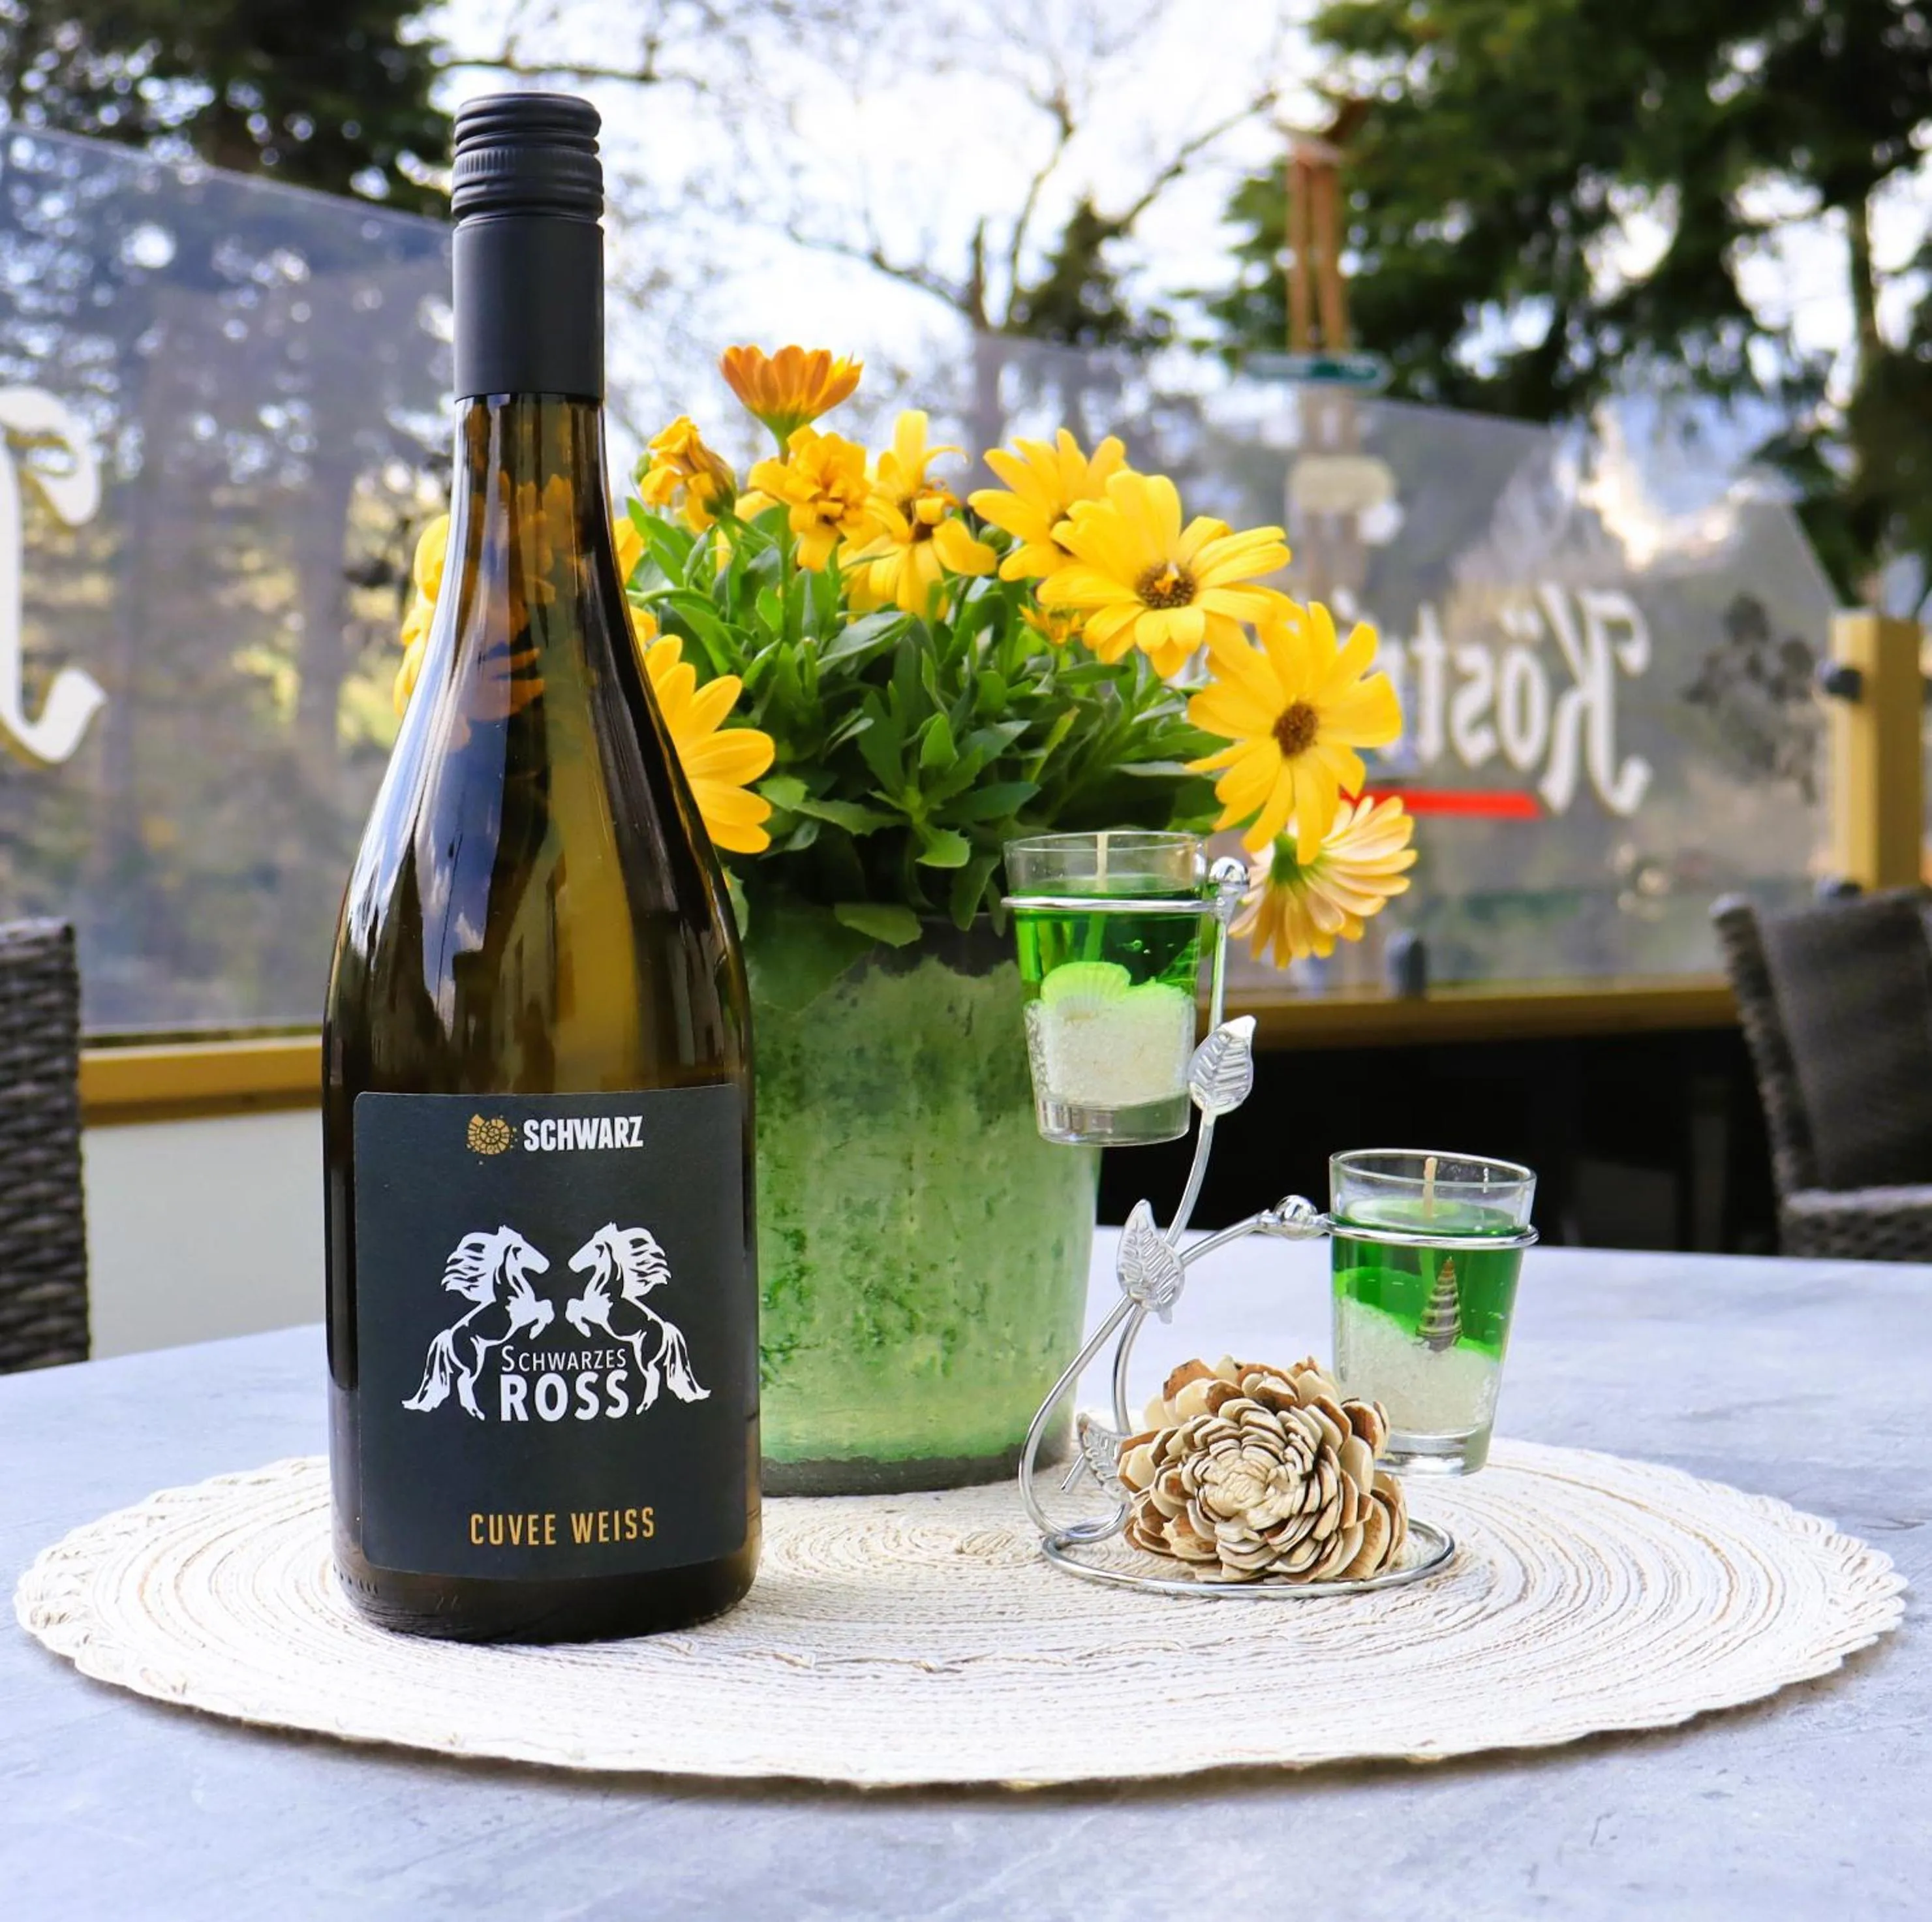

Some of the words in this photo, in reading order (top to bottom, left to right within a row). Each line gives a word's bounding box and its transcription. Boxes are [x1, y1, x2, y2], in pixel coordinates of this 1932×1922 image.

[523, 1115, 645, 1152] SCHWARZ
[499, 1369, 630, 1423] ROSS
[470, 1513, 557, 1546] CUVEE
[570, 1506, 655, 1544] WEISS
